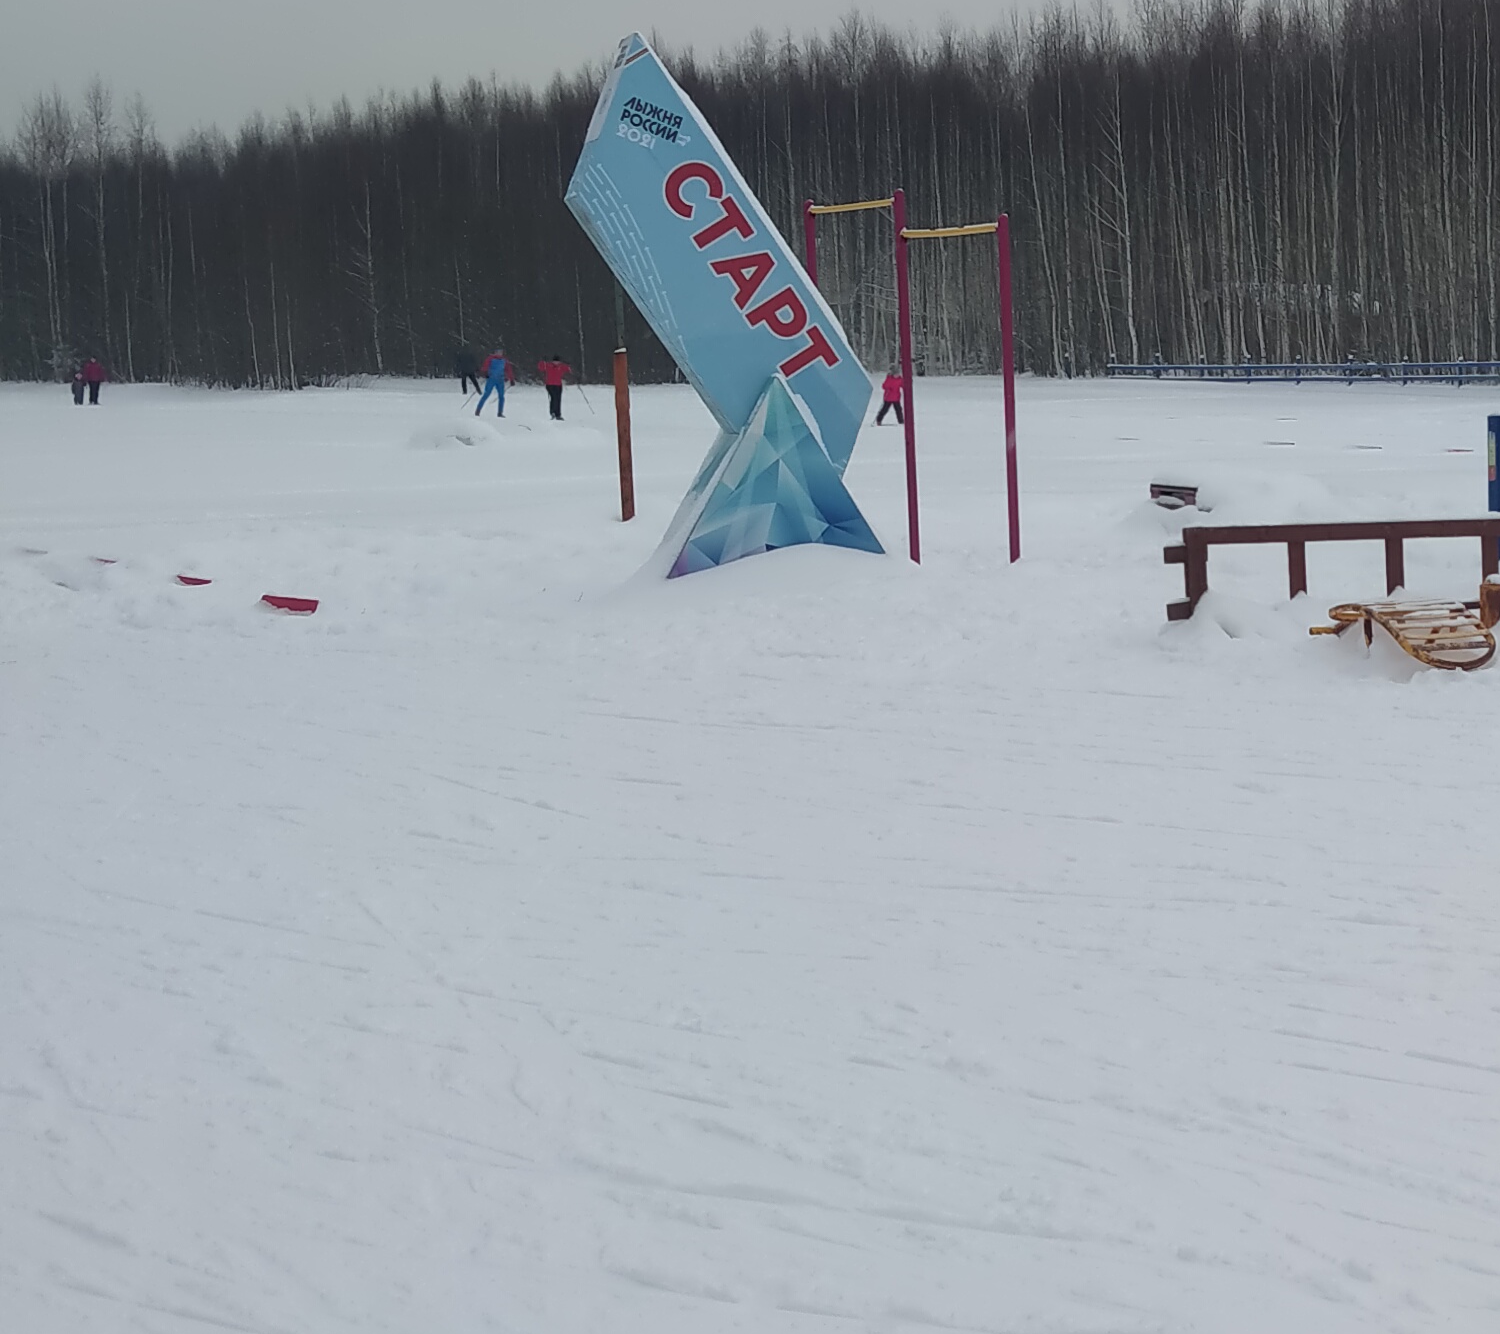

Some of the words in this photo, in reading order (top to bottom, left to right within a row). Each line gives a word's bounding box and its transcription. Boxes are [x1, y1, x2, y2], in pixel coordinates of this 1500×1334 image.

[620, 108, 679, 143] РОССИИ
[623, 96, 683, 129] ЛЫЖНЯ
[616, 123, 656, 150] 2021
[662, 161, 841, 380] СТАРТ
